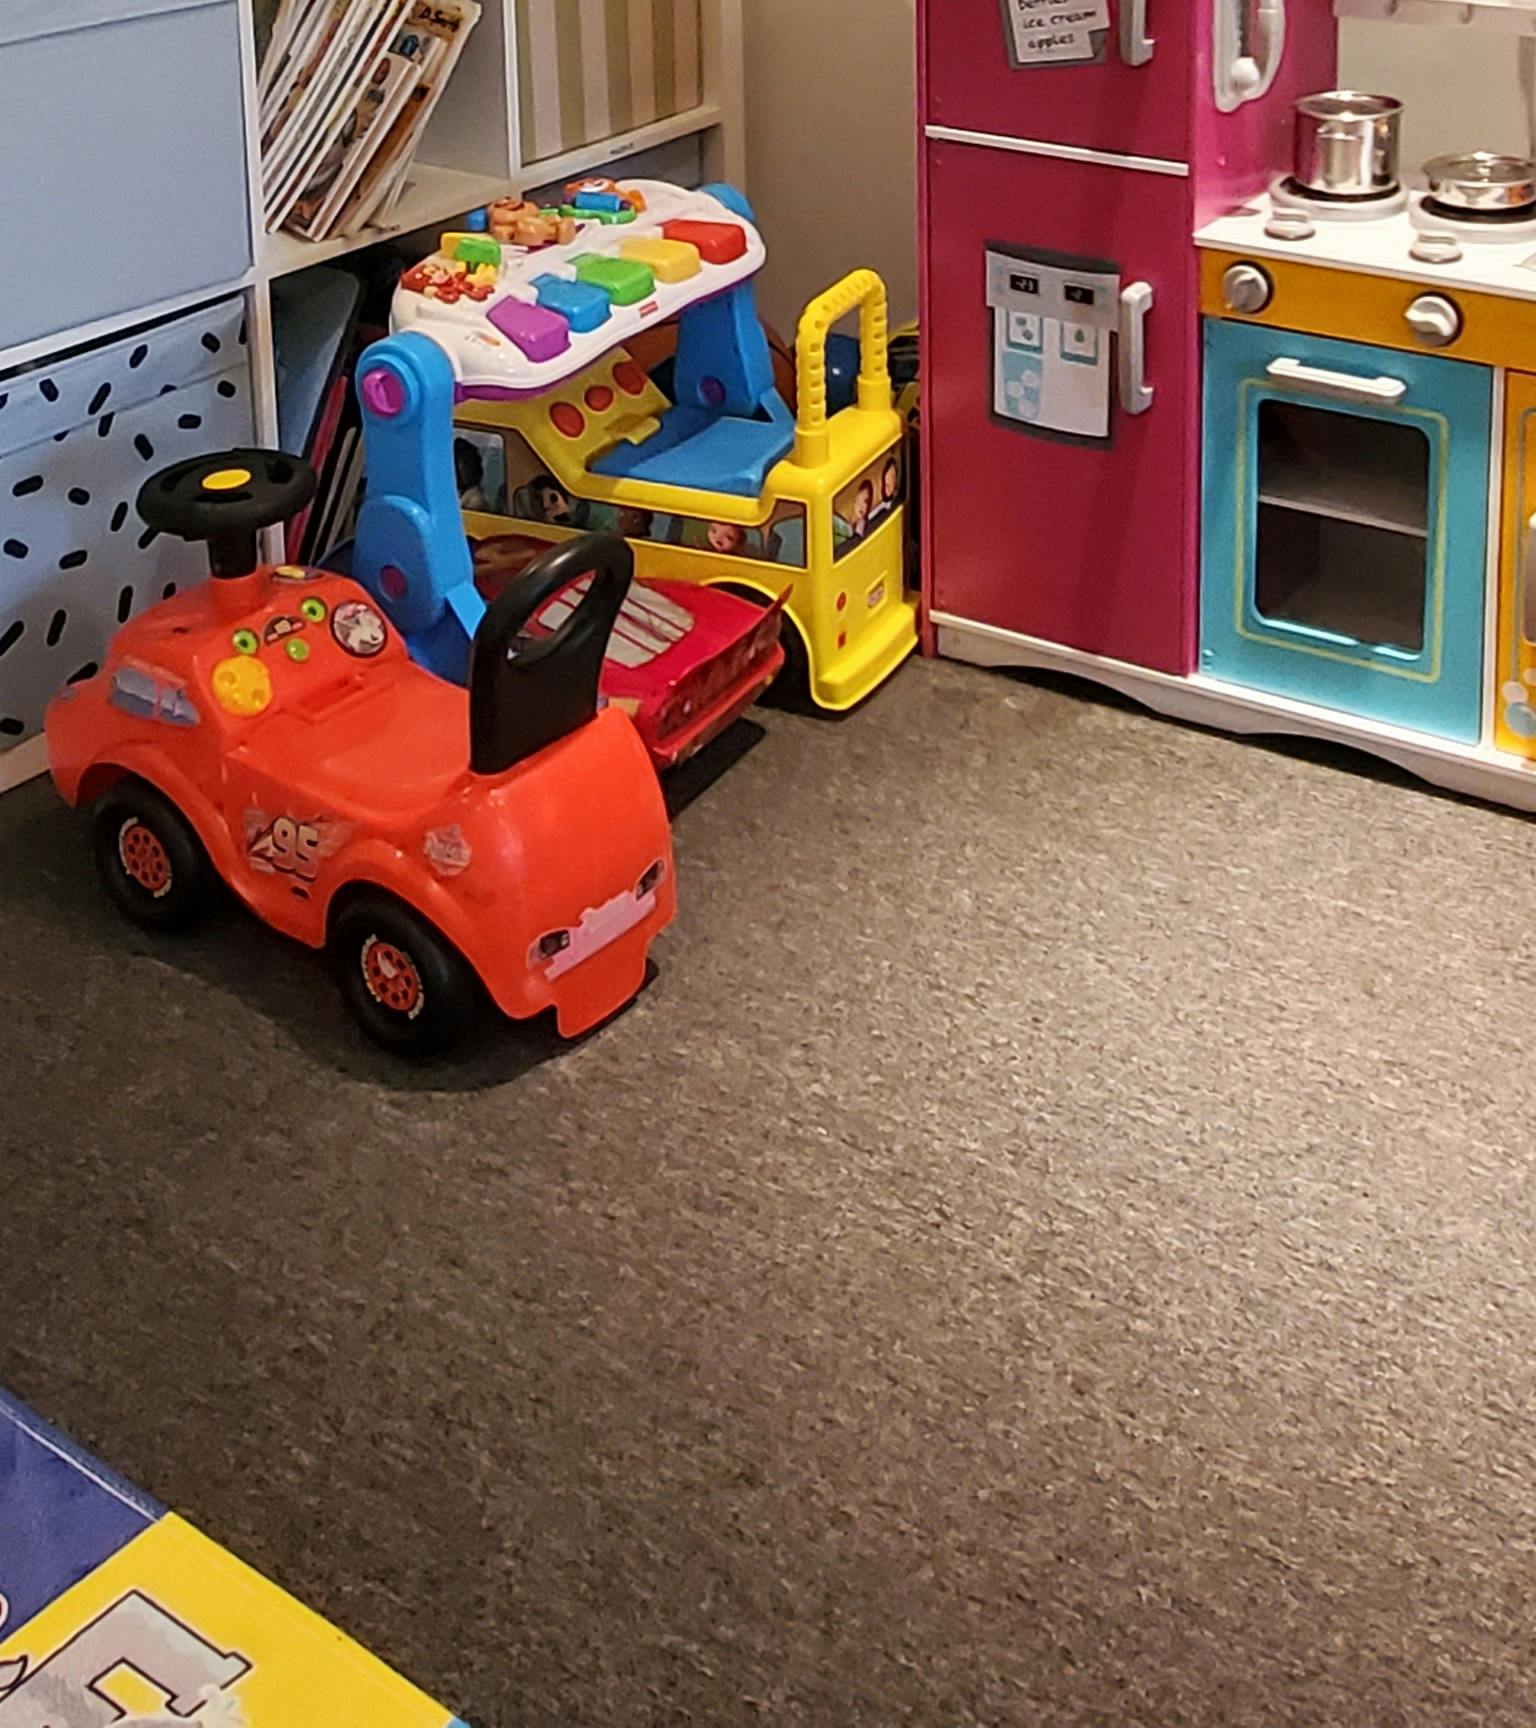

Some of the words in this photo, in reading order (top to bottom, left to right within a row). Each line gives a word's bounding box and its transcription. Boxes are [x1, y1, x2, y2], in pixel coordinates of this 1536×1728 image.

[1024, 17, 1045, 29] ice
[1051, 10, 1096, 23] cream
[1028, 33, 1075, 50] apples
[272, 817, 320, 880] 95
